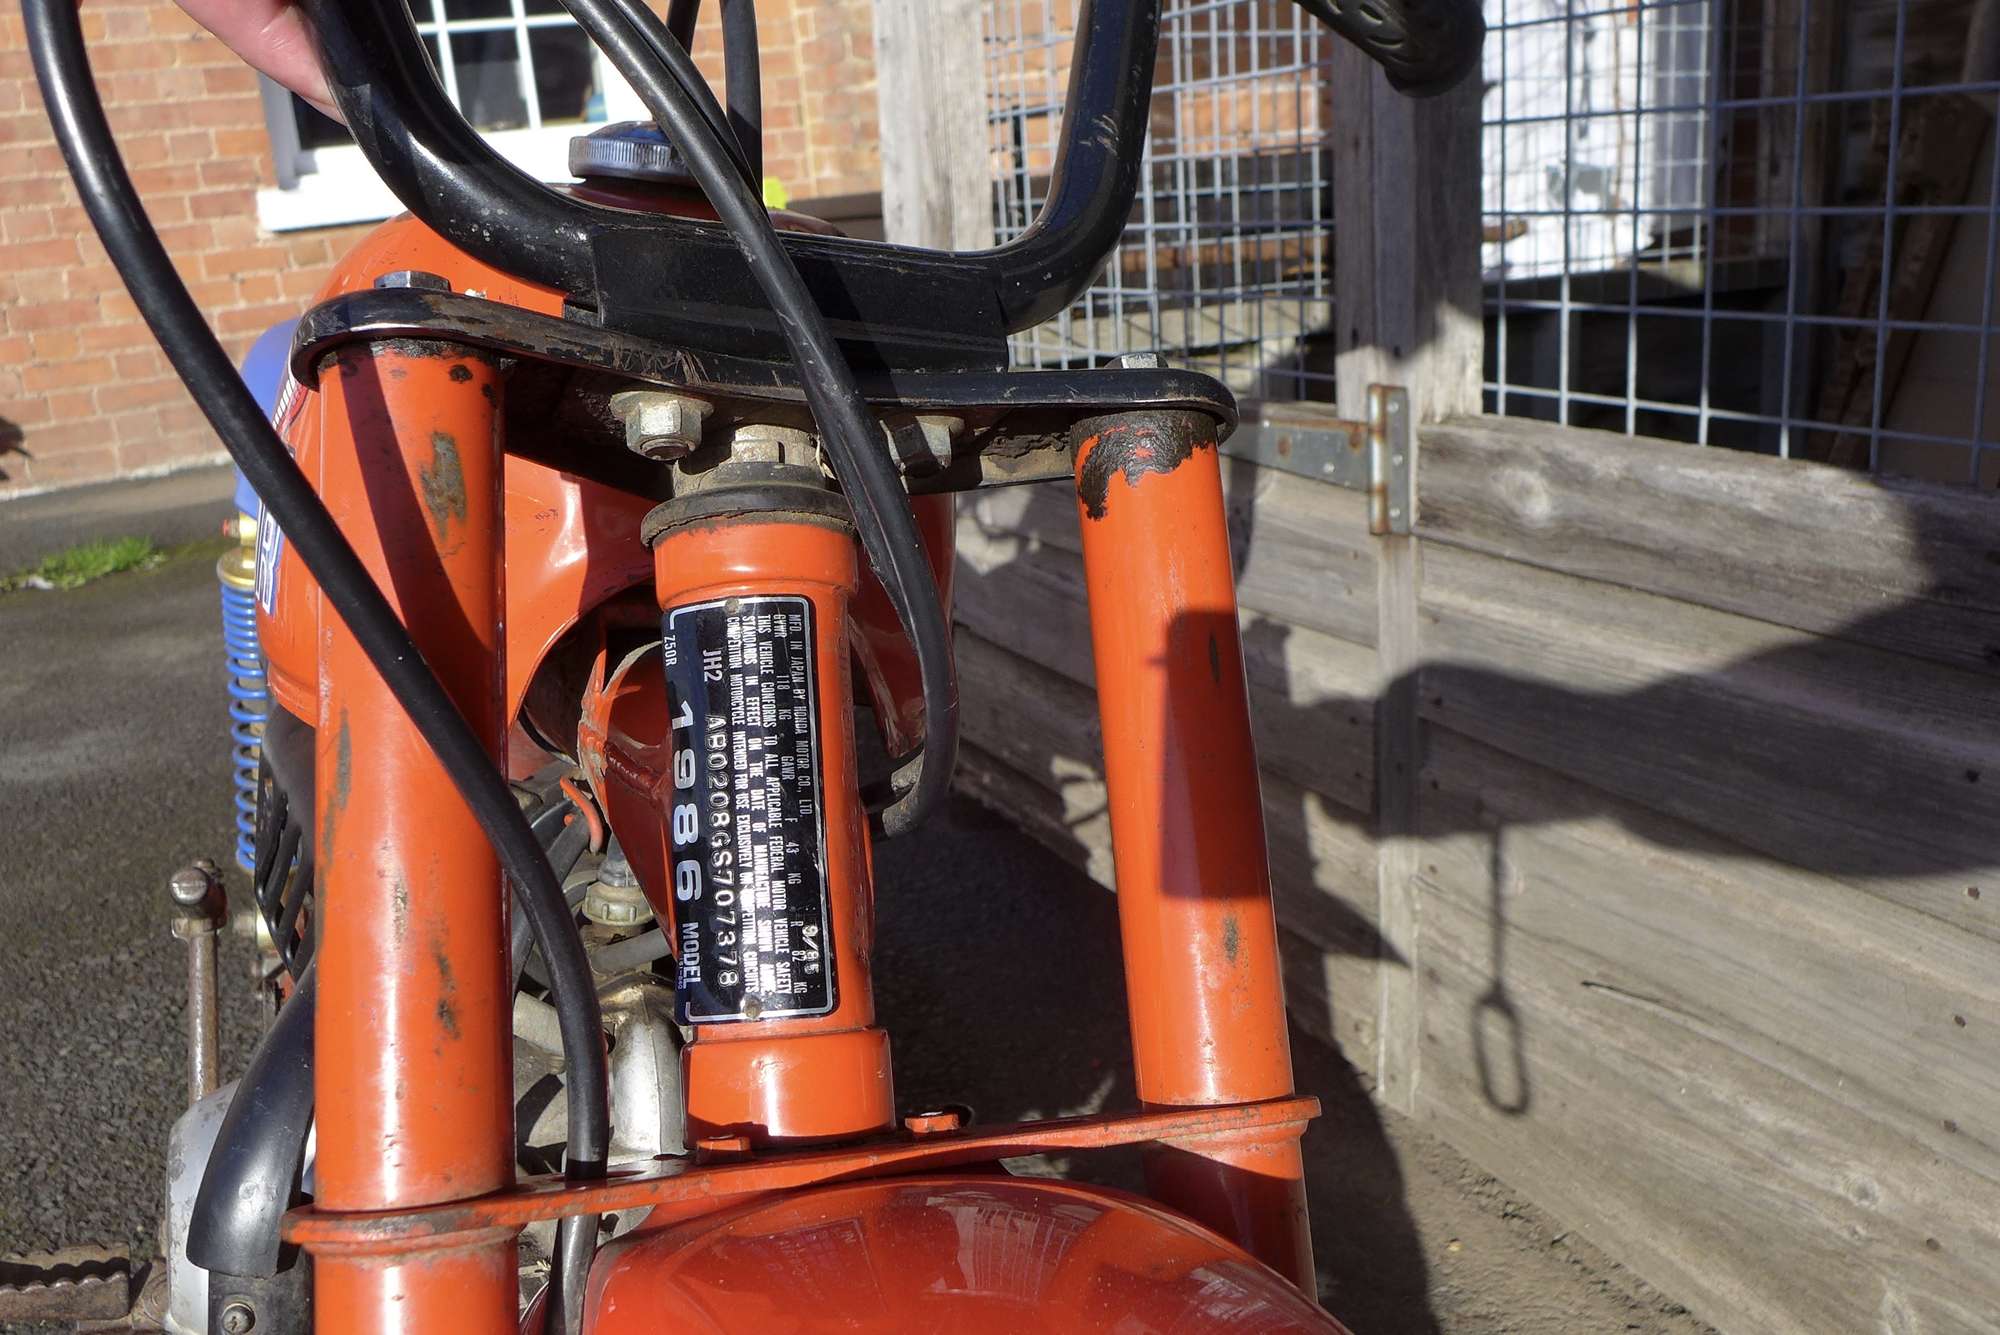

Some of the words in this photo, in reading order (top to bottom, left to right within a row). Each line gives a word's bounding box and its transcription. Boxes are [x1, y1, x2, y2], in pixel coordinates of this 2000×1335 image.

[758, 615, 771, 633] THIS
[774, 614, 787, 638] GVWR
[789, 614, 802, 634] MFD.
[664, 635, 677, 666] Z50R
[727, 617, 742, 668] COMPETITION
[742, 616, 757, 664] STANDARDS
[790, 641, 802, 650] IN
[703, 650, 722, 682] JH2
[759, 641, 773, 674] VEHICLE
[791, 656, 804, 682] JAPAN
[745, 676, 758, 685] IN
[777, 675, 790, 690] 118
[730, 674, 744, 725] MOTORCYCLE
[761, 682, 776, 727] CONFORMS
[793, 689, 806, 700] BY
[746, 697, 760, 726] EFFECT
[778, 710, 791, 720] KG
[794, 706, 808, 734] HONDA
[732, 731, 747, 770] INTENDED
[748, 738, 761, 750] ON
[764, 735, 777, 746] TO
[765, 754, 778, 769] ALL
[796, 740, 809, 768] MOTOR
[750, 762, 763, 778] THE
[781, 756, 795, 780] GAWR
[735, 774, 748, 790] FOR
[672, 701, 701, 900] 1986
[736, 793, 749, 809] USE
[751, 789, 764, 810] DATE
[766, 777, 782, 828] APPLICABLE
[799, 800, 812, 817] LTD.
[752, 822, 766, 832] OF
[737, 815, 752, 868] EXCLUSIVELY
[770, 836, 784, 872] FEDERAL
[786, 842, 799, 854] 43
[754, 845, 770, 908] MANUFACTURE
[788, 873, 801, 884] KG
[772, 880, 786, 910] MOTOR
[774, 918, 789, 954] VEHICLE
[682, 922, 700, 988] MODEL
[743, 951, 759, 992] CIRCUITS
[776, 962, 792, 994] SAFETY
[794, 982, 807, 994] KG
